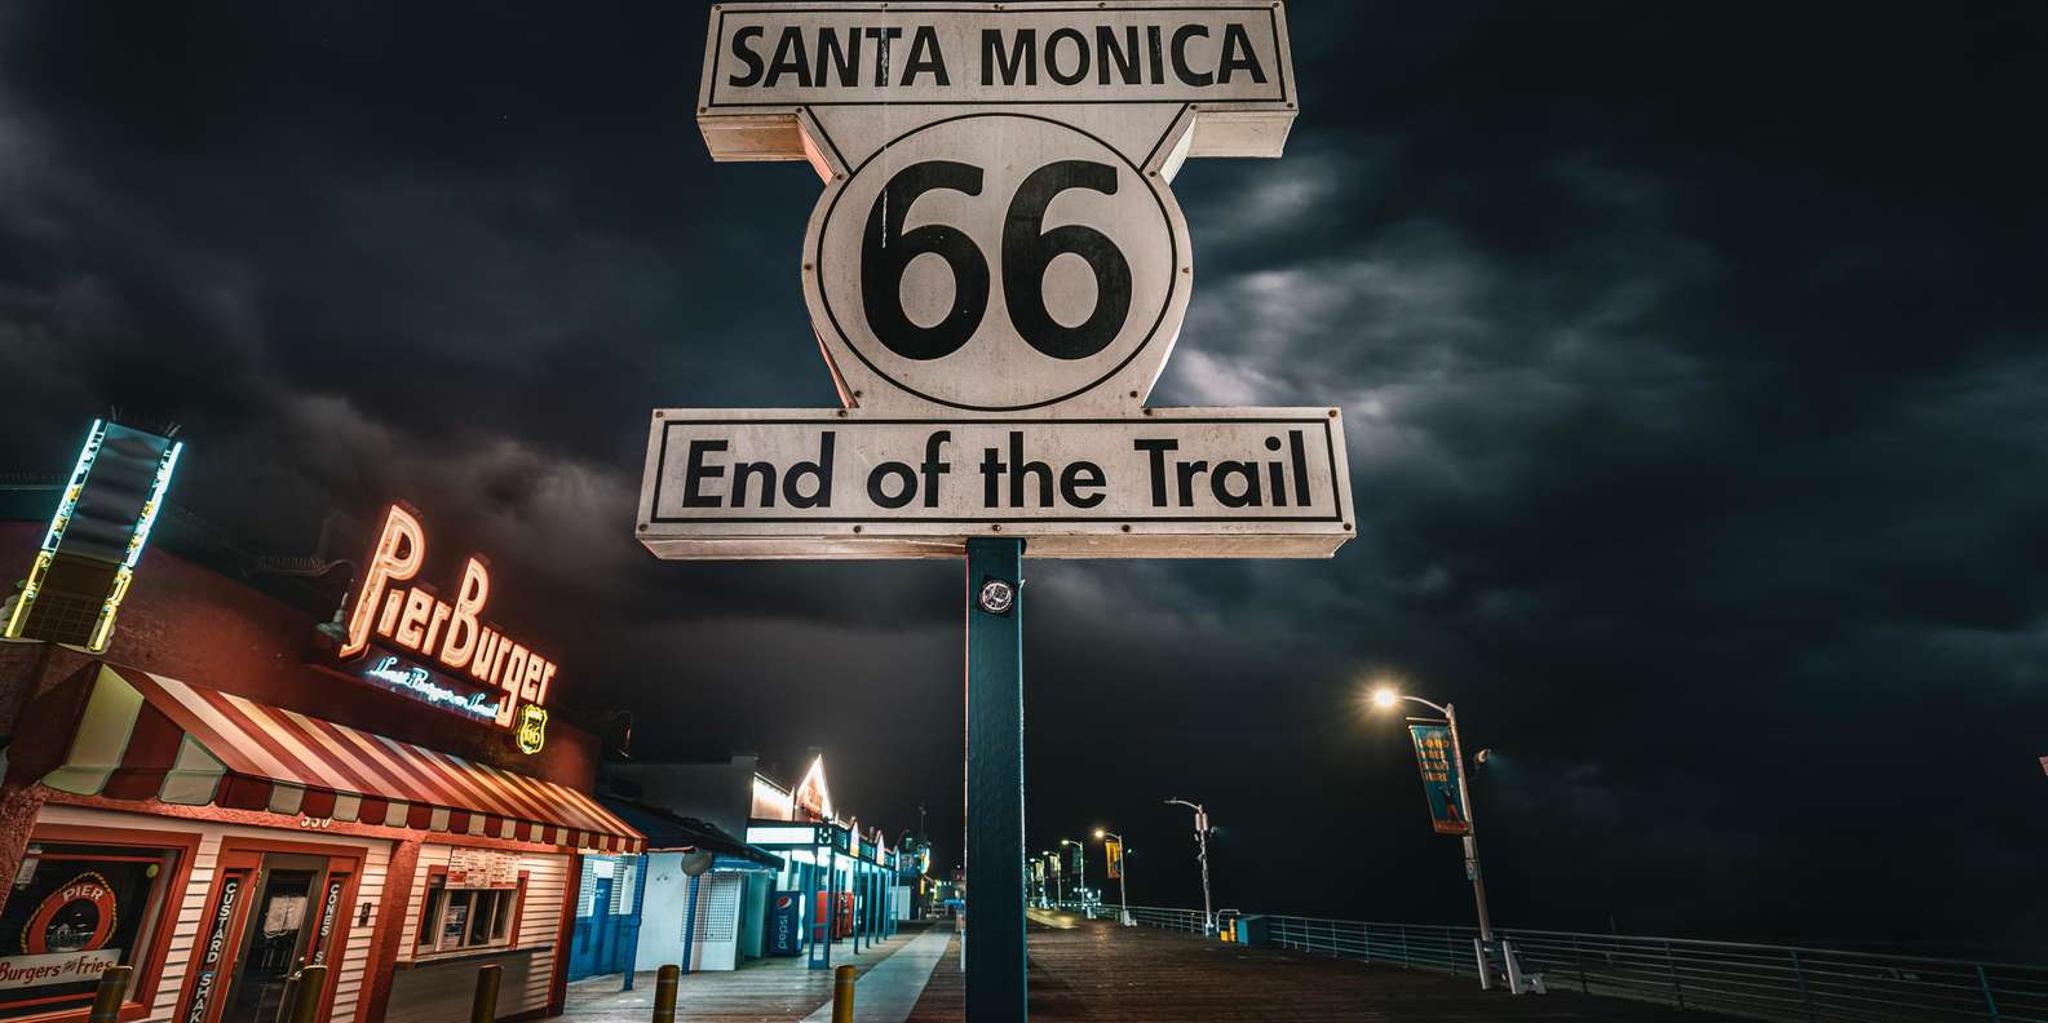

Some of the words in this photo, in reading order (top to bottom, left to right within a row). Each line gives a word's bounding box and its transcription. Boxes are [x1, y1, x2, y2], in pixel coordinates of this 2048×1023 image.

[728, 26, 950, 89] SANTA
[980, 23, 1268, 88] MONICA
[860, 159, 1133, 361] 66
[682, 430, 836, 509] End
[866, 430, 952, 509] of
[979, 430, 1107, 509] the
[1134, 430, 1312, 509] Trail
[62, 884, 104, 901] PIER
[207, 882, 236, 963] CUSTARD
[320, 883, 340, 936] CONES
[0, 961, 61, 985] Burgers
